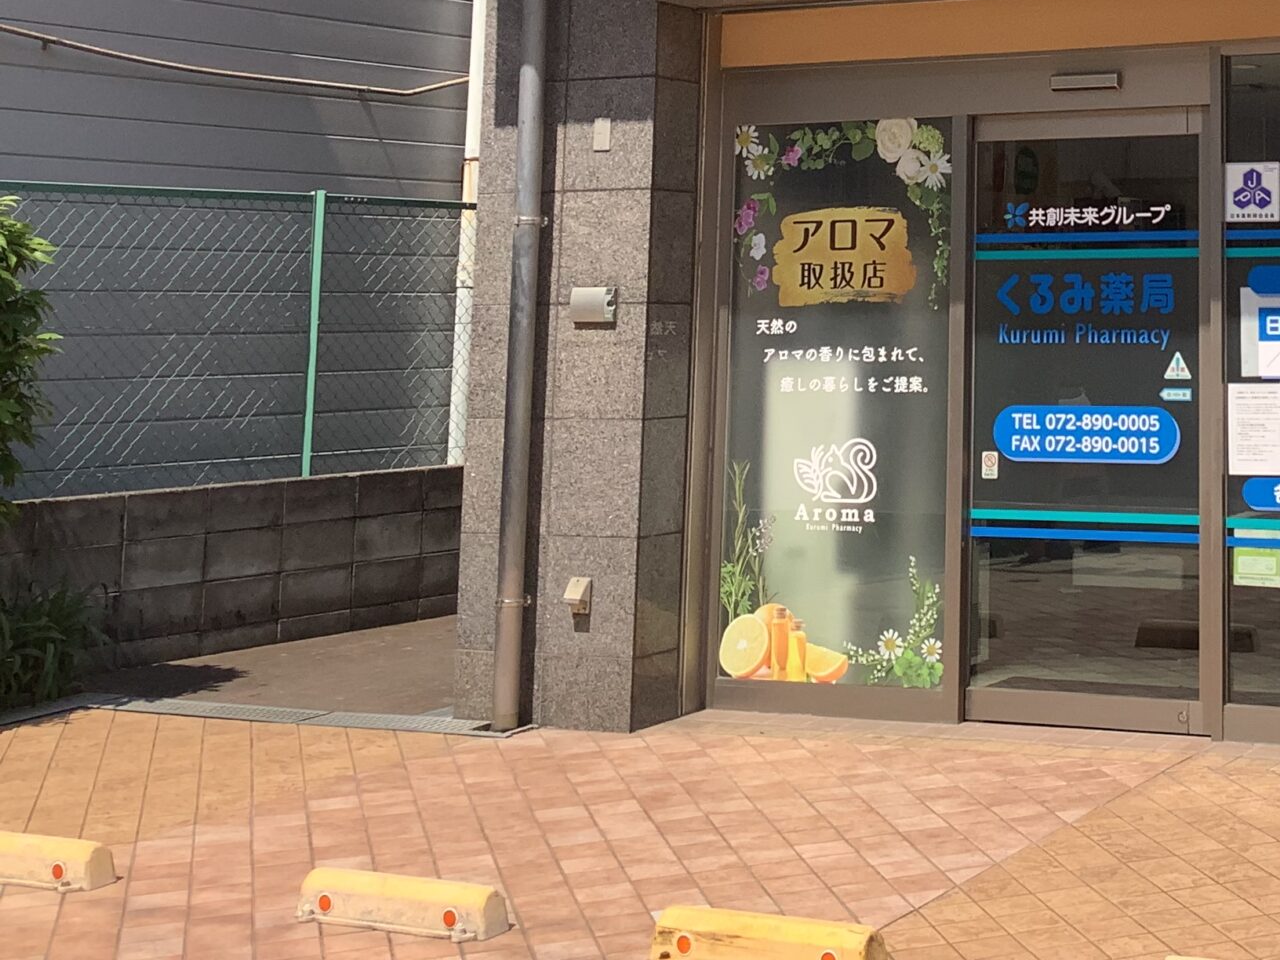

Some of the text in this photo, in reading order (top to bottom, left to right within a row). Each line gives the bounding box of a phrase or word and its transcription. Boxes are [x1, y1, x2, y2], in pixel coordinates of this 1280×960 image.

[1028, 204, 1171, 227] 共創未来グループ
[792, 218, 895, 253] アロマ
[799, 260, 887, 290] 取扱店
[996, 272, 1175, 316] くるみ薬局
[756, 319, 797, 335] 天然の
[999, 322, 1171, 350] Kurumi Pharmacy
[763, 346, 925, 363] アロマの香りに包まれて、
[780, 376, 929, 393] 癒しの暮らしをご提案。
[1011, 413, 1160, 431] TEL 072-890-0005
[1011, 435, 1160, 453] FAX 072-890-0015
[794, 503, 875, 522] Aroma
[832, 524, 863, 534] Pharmacy
